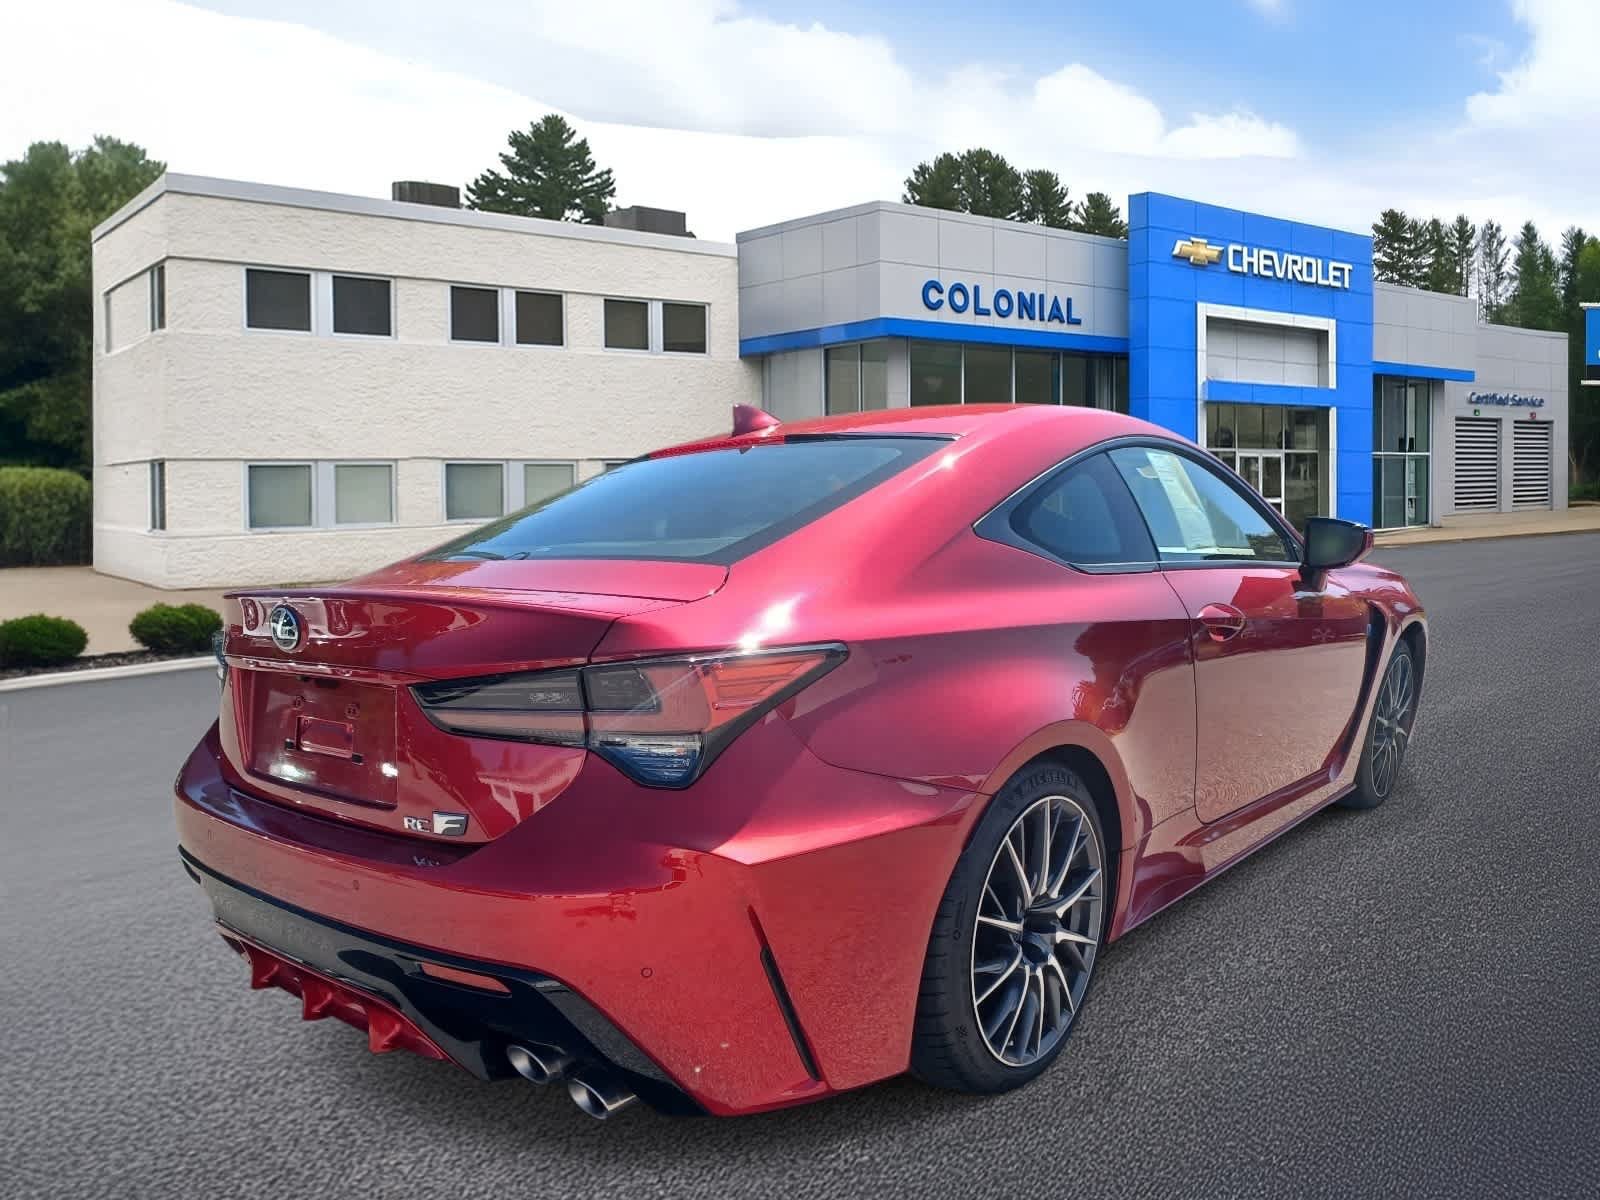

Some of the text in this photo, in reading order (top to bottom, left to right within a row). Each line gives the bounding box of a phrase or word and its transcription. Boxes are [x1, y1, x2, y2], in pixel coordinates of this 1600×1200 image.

[1228, 243, 1353, 289] CHEVROLET
[922, 279, 1082, 326] COLONIAL
[1468, 391, 1545, 408] Certified Service
[403, 812, 466, 836] RC F
